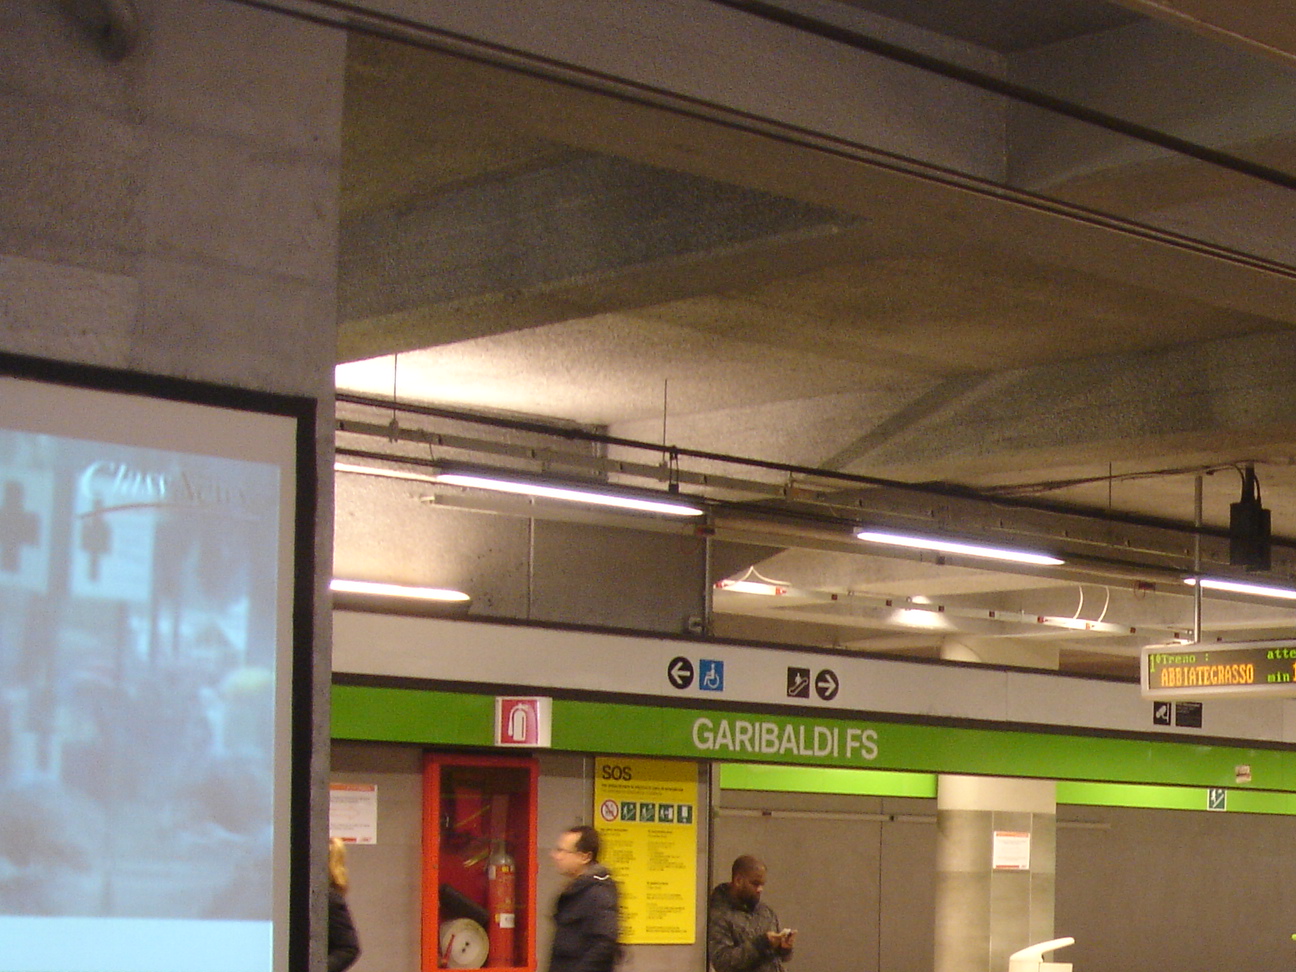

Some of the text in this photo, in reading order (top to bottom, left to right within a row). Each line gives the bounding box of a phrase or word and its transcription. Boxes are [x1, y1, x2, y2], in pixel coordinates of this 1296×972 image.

[1160, 663, 1254, 687] ABBIATEGRASSO
[1267, 671, 1290, 683] min
[692, 717, 878, 760] GARIBALDI FS
[602, 764, 632, 781] SOS
